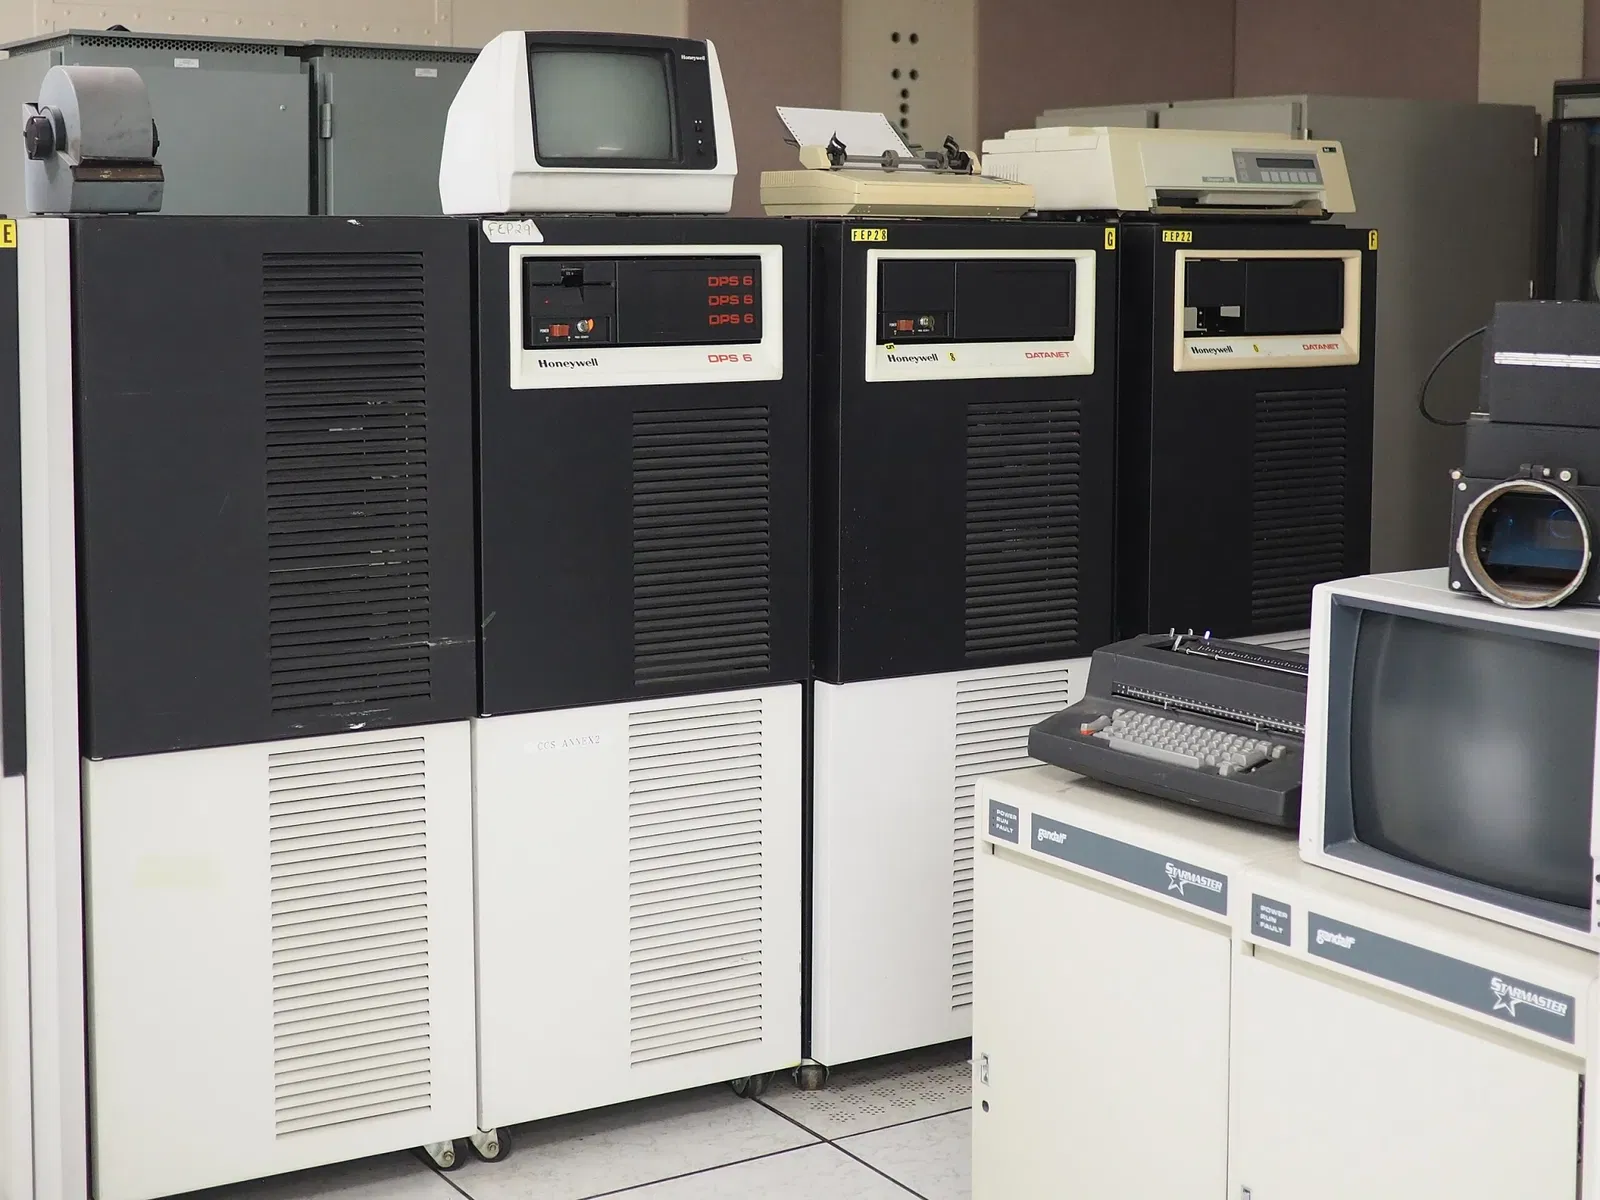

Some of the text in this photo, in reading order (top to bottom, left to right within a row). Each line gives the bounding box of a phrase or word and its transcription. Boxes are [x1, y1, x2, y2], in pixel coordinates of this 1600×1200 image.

[3, 223, 13, 244] E
[853, 230, 886, 240] FEP28
[1107, 231, 1114, 247] G
[1163, 231, 1192, 242] FEP22
[1370, 232, 1377, 248] F
[707, 275, 752, 287] DPS 6
[708, 294, 753, 306] DPS 6
[709, 313, 754, 325] DPS 6
[1191, 345, 1233, 355] Honeywell
[1302, 343, 1339, 351] DATANET
[708, 353, 753, 363] DPS 6
[887, 353, 939, 364] Honeywell
[1025, 351, 1070, 359] DATANET
[538, 358, 599, 370] Honeywell
[996, 809, 1017, 820] POWER
[996, 816, 1009, 825] RUN
[996, 823, 1014, 834] FAULT
[1165, 862, 1223, 892] STARMASTER
[1260, 905, 1288, 919] POWER
[1260, 913, 1277, 924] RUN
[1260, 921, 1284, 934] FAULT
[1490, 976, 1568, 1015] STARMASTER
